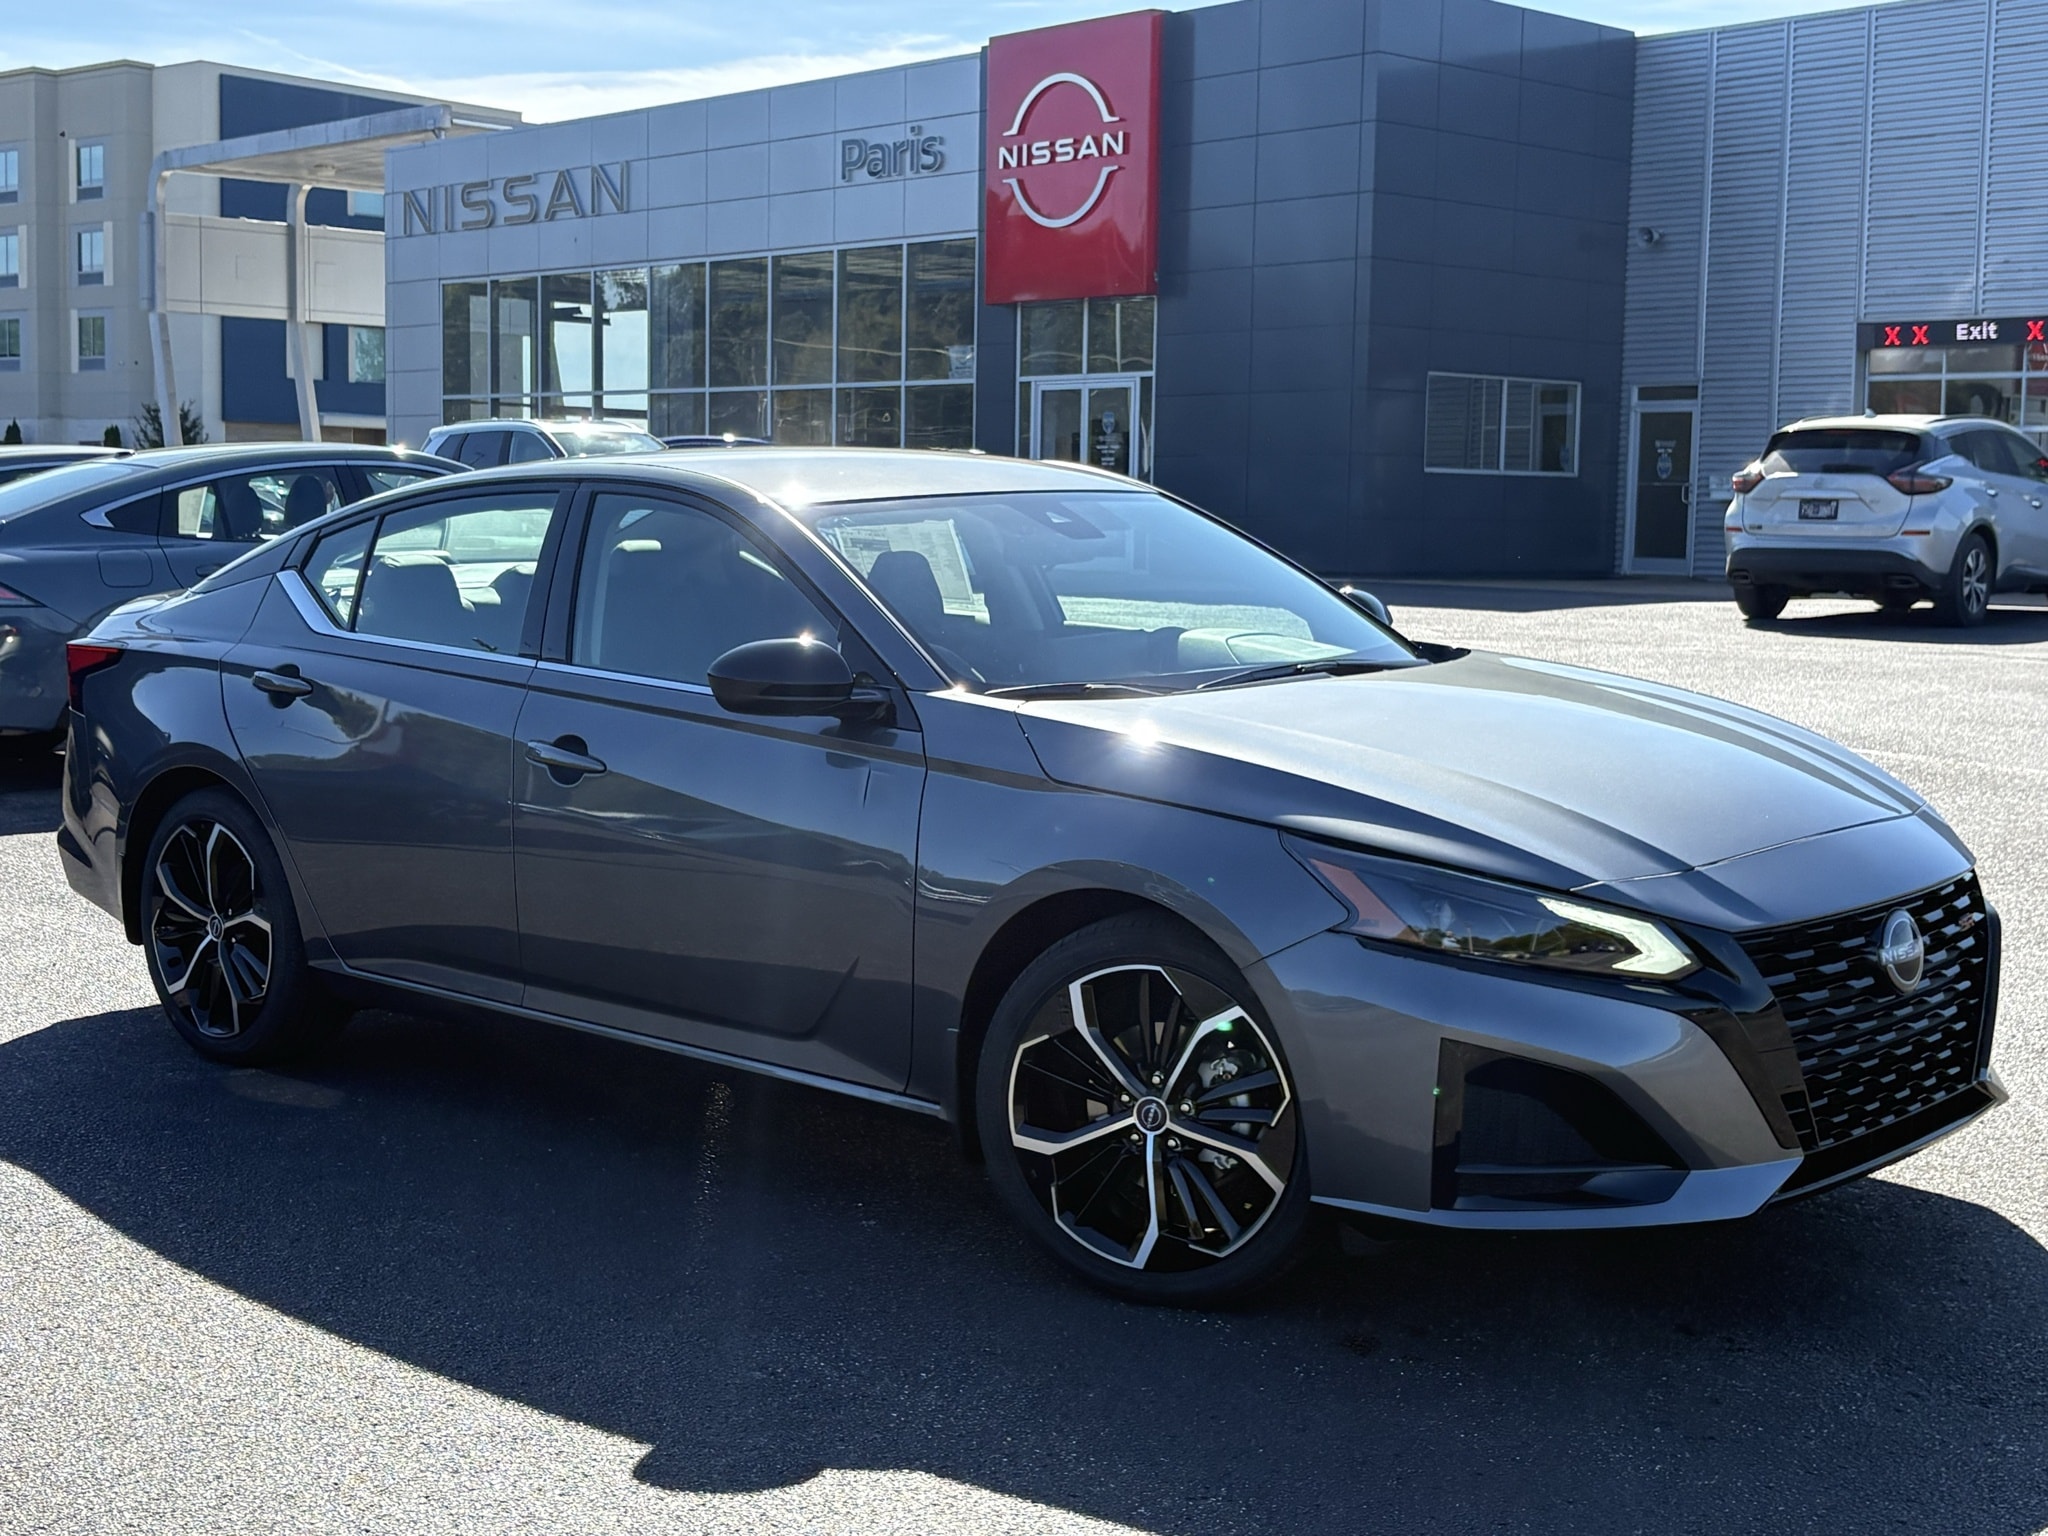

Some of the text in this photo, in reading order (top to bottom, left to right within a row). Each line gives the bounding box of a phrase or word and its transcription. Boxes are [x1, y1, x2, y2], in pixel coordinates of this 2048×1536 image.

[841, 125, 944, 182] Paris
[999, 131, 1124, 169] NISSAN
[402, 160, 629, 237] NISSAN
[1956, 321, 1999, 340] Exit
